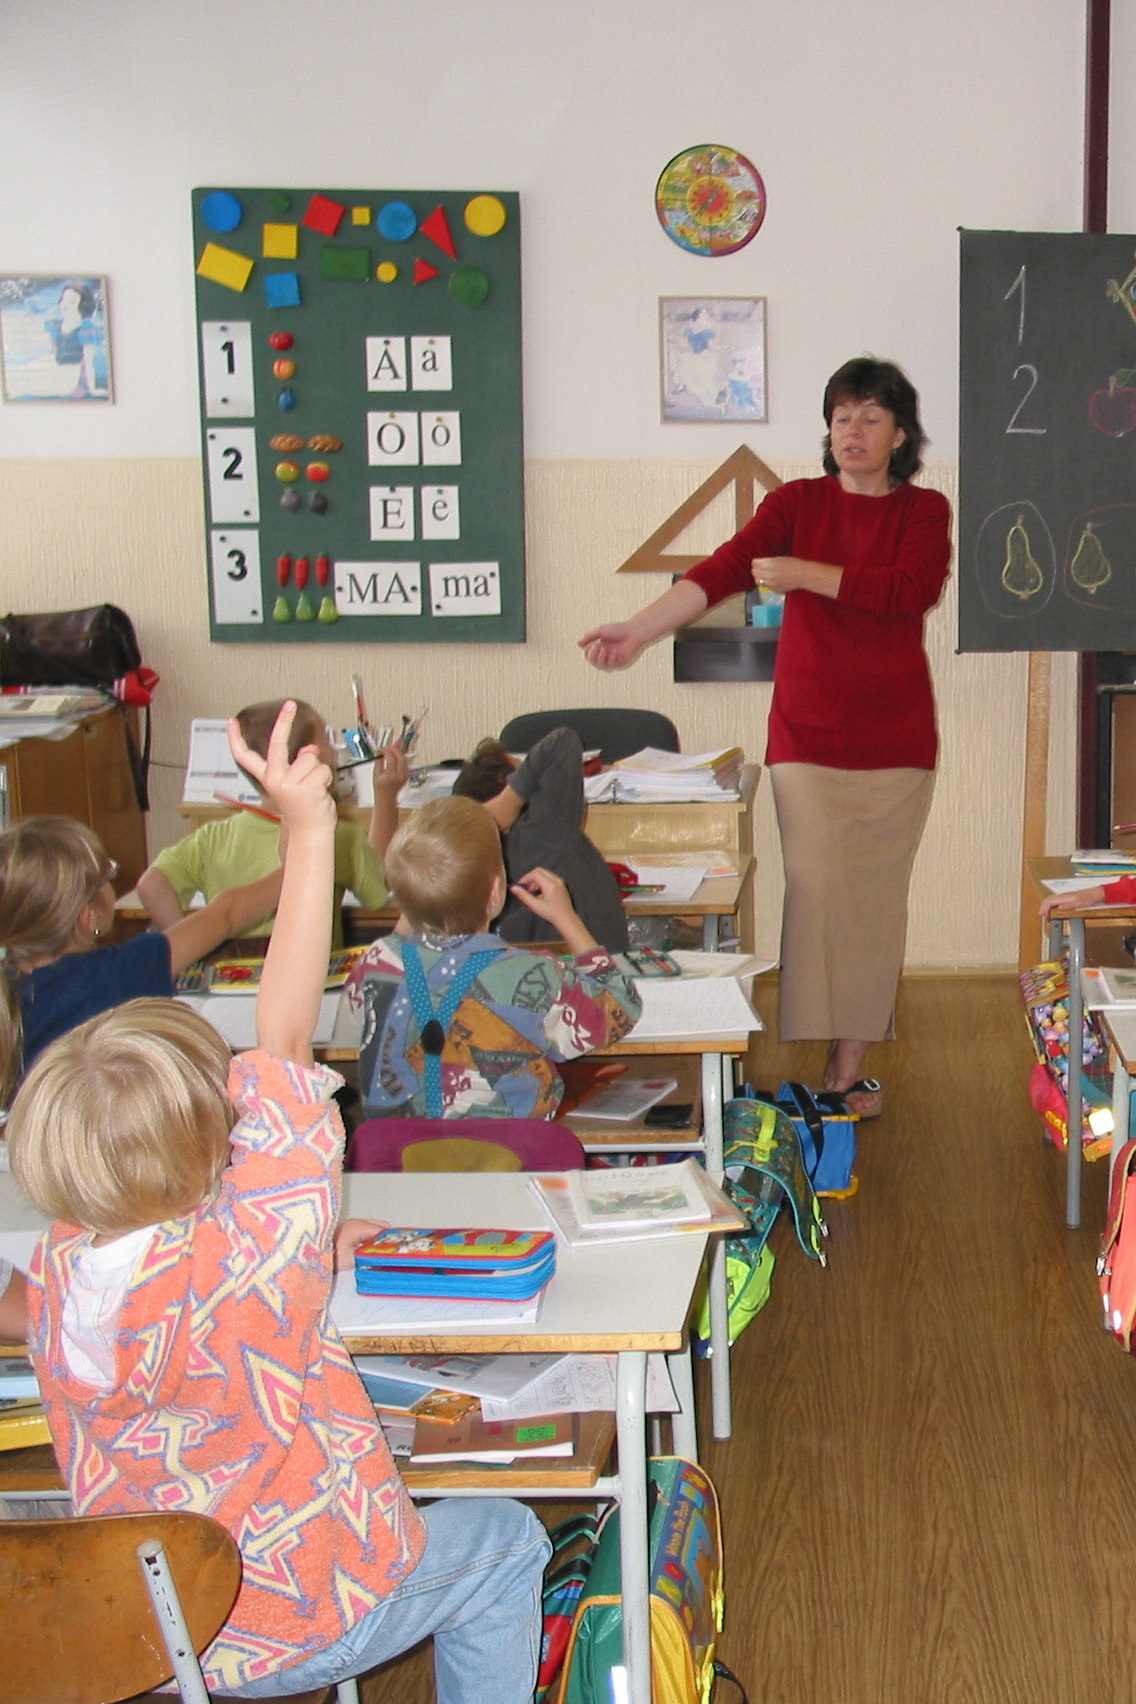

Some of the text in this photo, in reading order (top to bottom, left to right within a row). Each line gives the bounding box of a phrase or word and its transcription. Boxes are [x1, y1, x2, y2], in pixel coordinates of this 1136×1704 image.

[1003, 264, 1026, 346] 1
[220, 341, 235, 375] 1
[371, 347, 440, 380] A a
[1005, 363, 1047, 435] 2
[377, 422, 451, 455] O o
[222, 447, 244, 481] 2
[379, 498, 450, 530] E e
[227, 549, 248, 582] 3
[346, 571, 492, 604] MA ma
